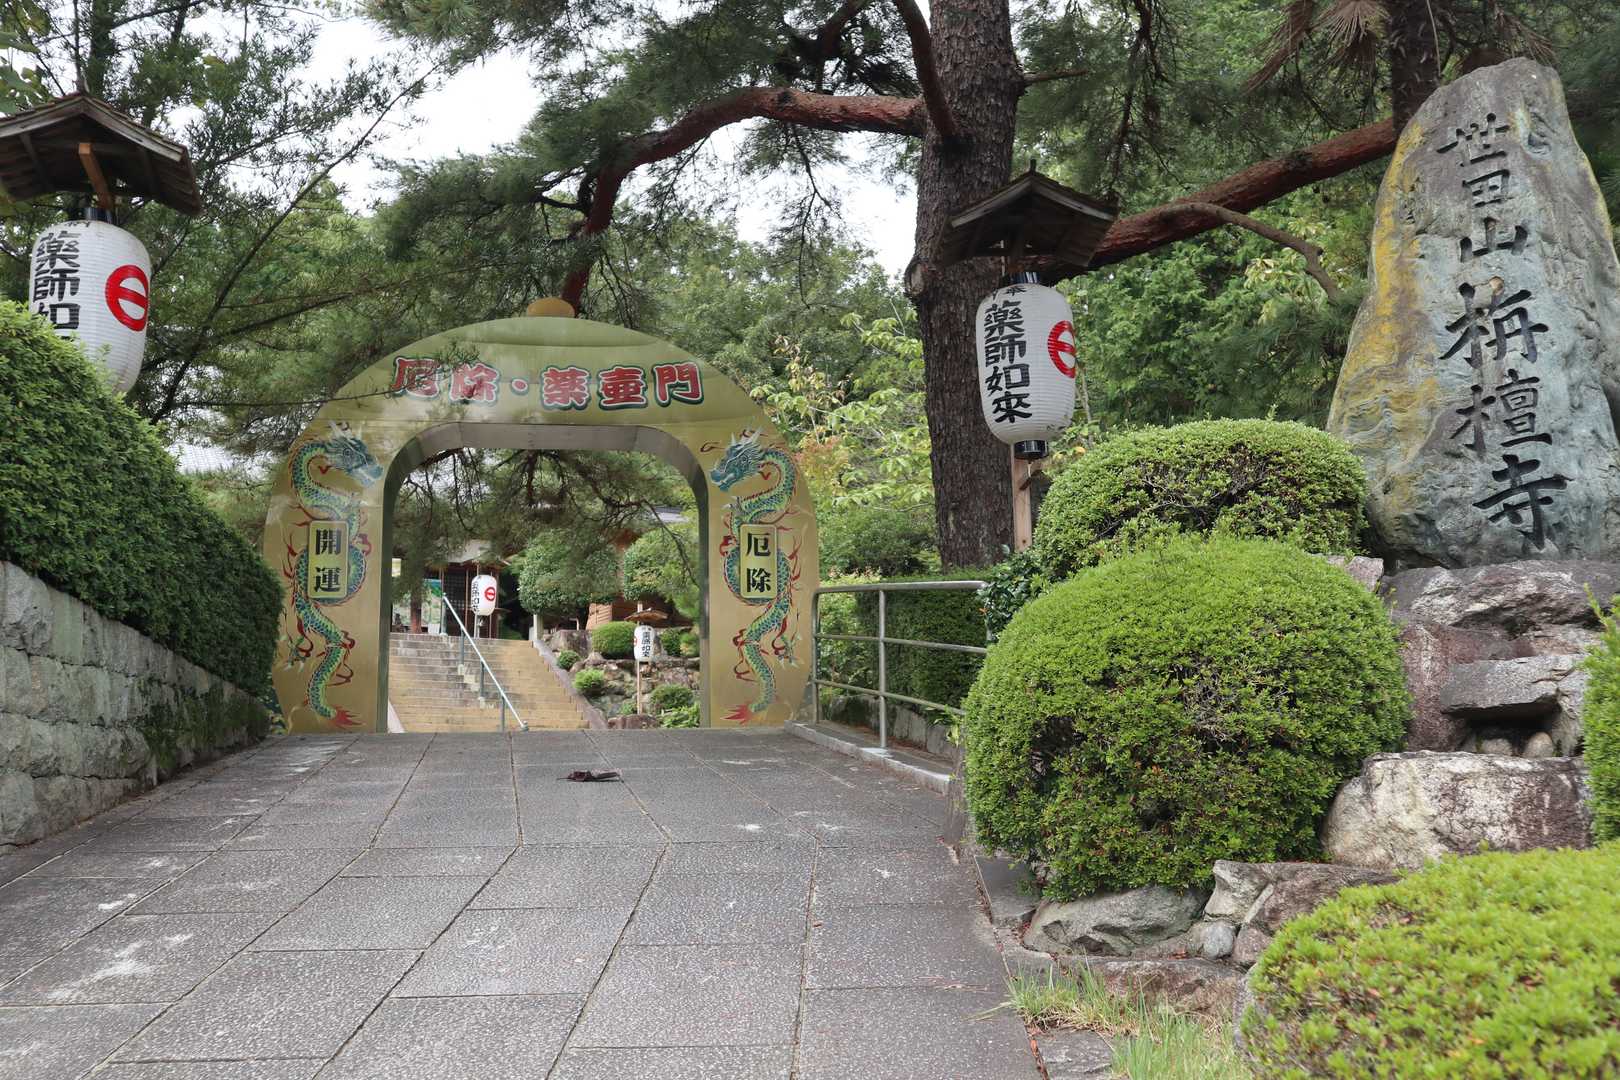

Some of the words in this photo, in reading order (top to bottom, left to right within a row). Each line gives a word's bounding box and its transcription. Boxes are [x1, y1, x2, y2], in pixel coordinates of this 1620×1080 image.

[33, 230, 80, 342] 藥師如
[314, 528, 342, 592] 開運
[745, 532, 771, 592] 厄除
